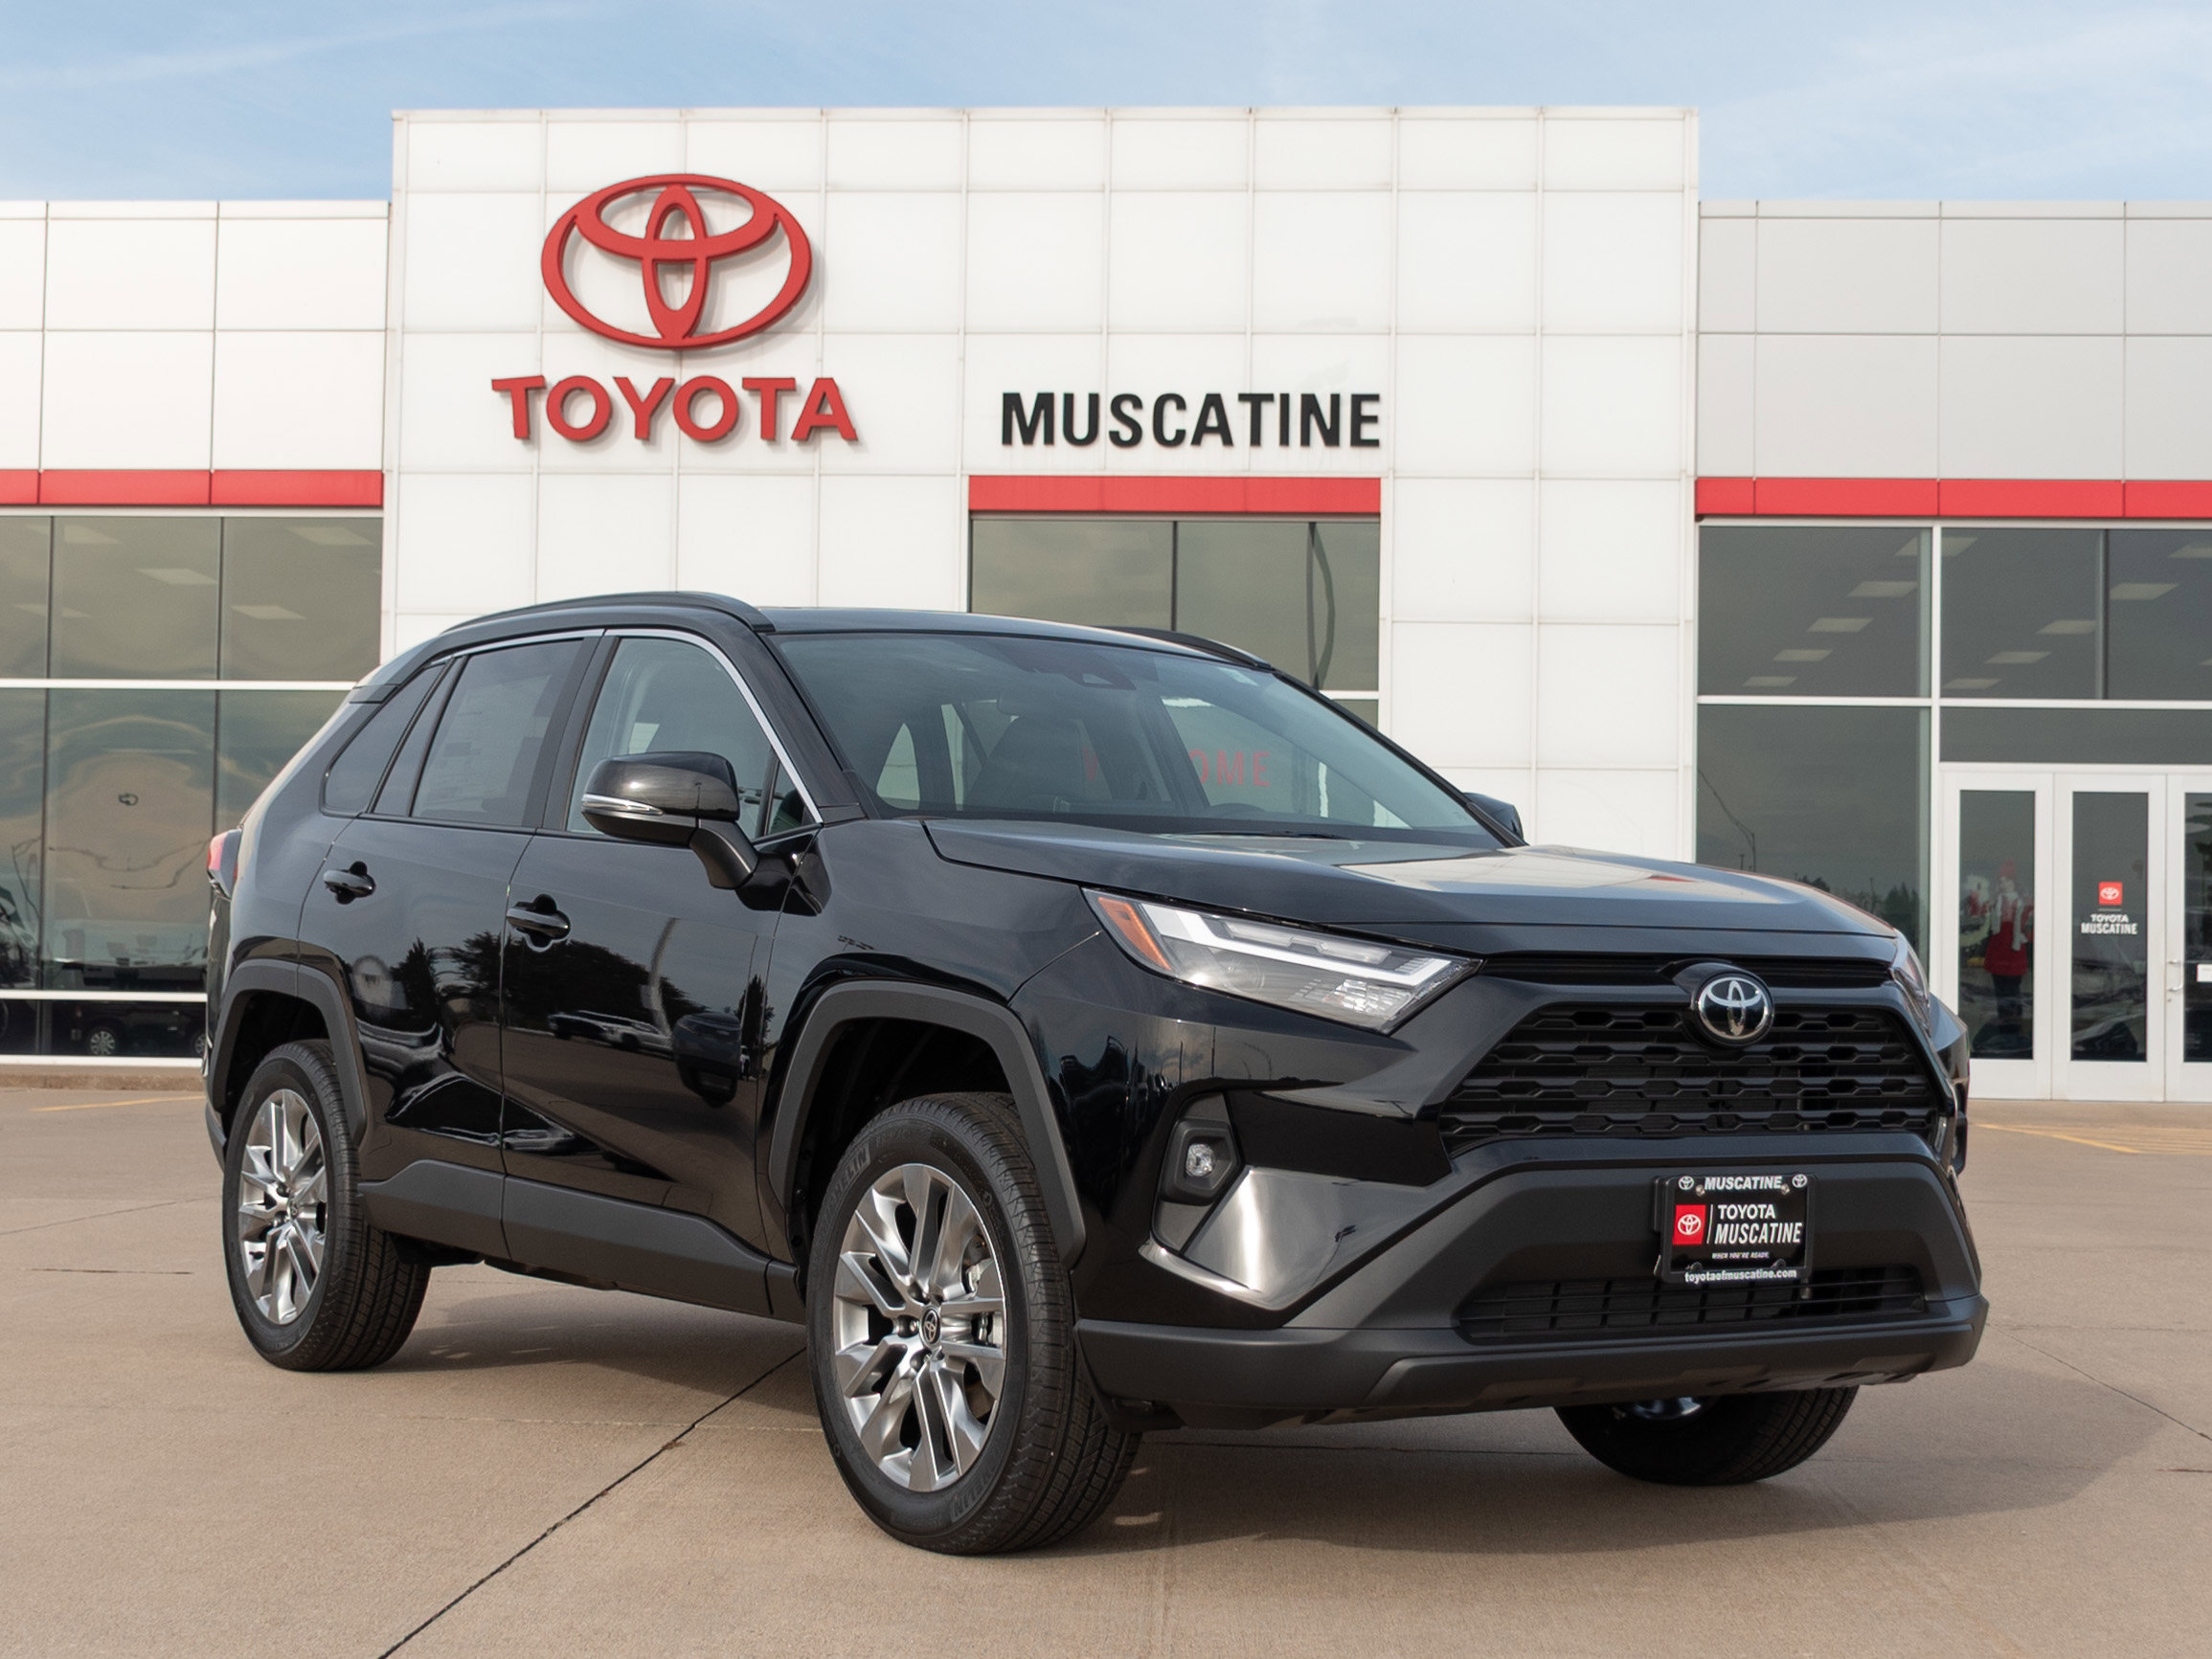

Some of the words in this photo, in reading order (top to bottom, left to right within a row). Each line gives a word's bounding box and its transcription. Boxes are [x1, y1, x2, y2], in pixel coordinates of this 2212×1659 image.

[492, 376, 858, 443] TOYOTA
[1002, 392, 1380, 447] MUSCATINE
[1082, 747, 1271, 786] WOME
[2090, 913, 2129, 922] TOYOTA
[2081, 923, 2137, 934] MUSCATINE
[1704, 1176, 1782, 1190] MUSCATINE
[1718, 1204, 1775, 1220] TOYOTA
[1714, 1222, 1802, 1244] MUSCATINE
[1684, 1269, 1797, 1285] toyotaofmuscatine.com
